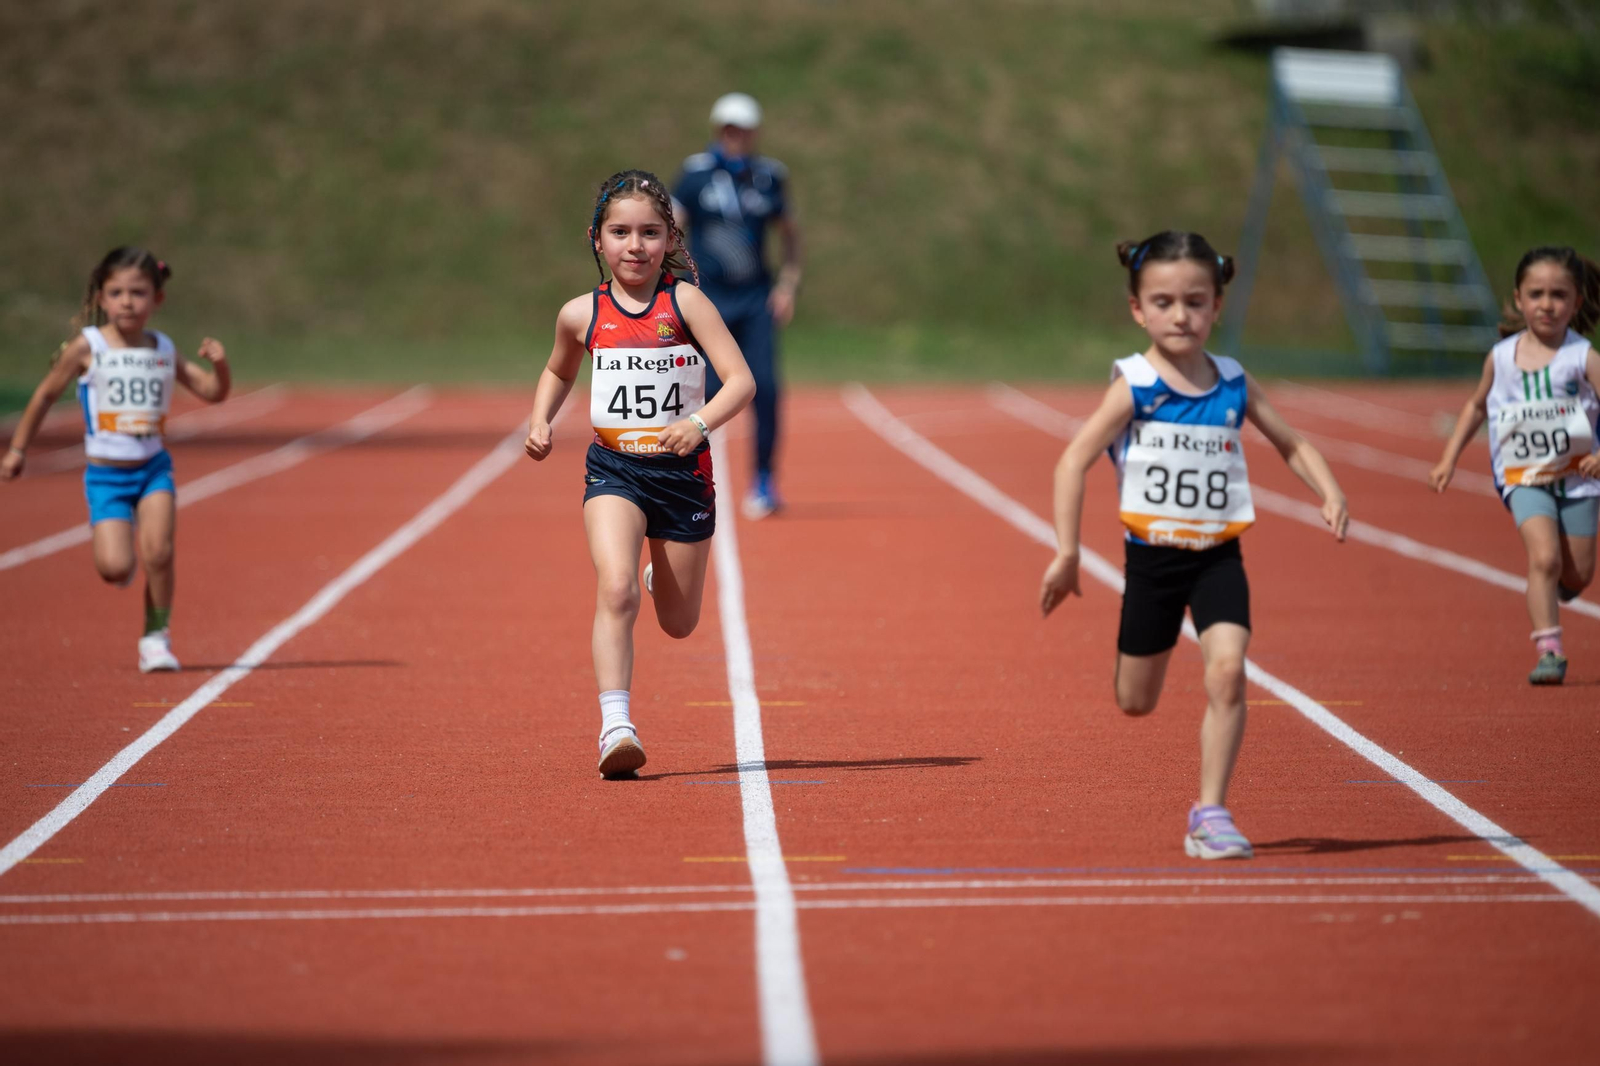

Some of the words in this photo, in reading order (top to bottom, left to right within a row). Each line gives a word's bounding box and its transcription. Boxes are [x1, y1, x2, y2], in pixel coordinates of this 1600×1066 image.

[596, 355, 621, 370] La
[626, 353, 698, 373] Región
[108, 377, 163, 407] 389
[607, 382, 684, 420] 454
[1134, 427, 1164, 449] La
[1511, 428, 1570, 459] 390
[1144, 465, 1228, 510] 368
